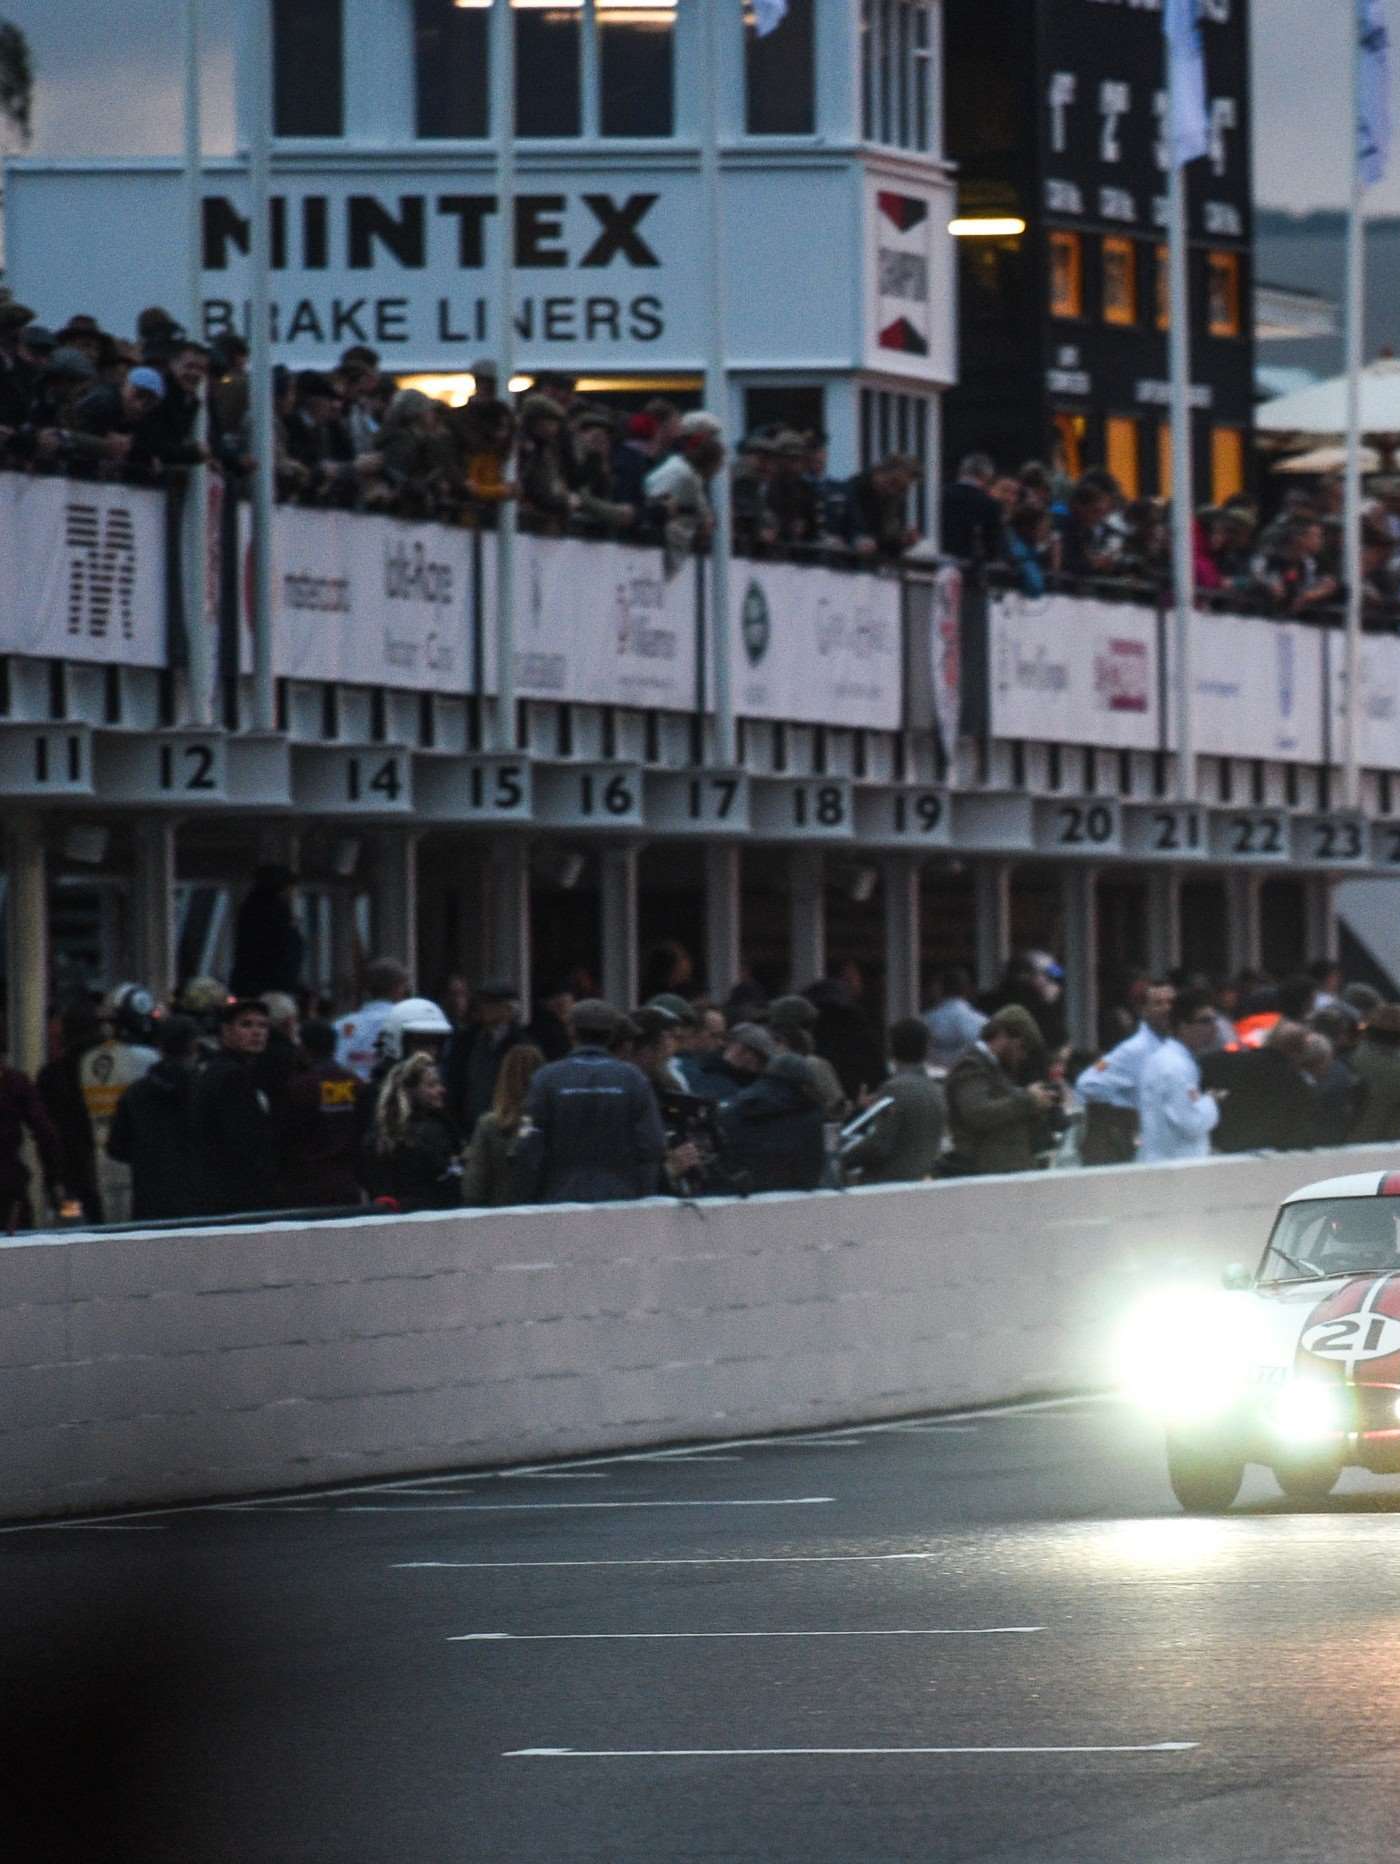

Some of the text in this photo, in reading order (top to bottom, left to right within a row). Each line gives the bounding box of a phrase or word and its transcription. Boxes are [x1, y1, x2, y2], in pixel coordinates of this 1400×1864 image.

[202, 194, 663, 272] MINTEX
[35, 735, 81, 783] 11
[160, 744, 215, 790] 12
[348, 757, 402, 801] 14
[472, 766, 521, 809] 15
[581, 774, 633, 816] 16
[690, 778, 738, 819] 17
[794, 786, 844, 828] 18
[895, 793, 942, 833] 19
[1060, 806, 1112, 843] 20
[1156, 812, 1199, 850] 21
[1232, 817, 1282, 854] 22
[1316, 822, 1363, 859] 23
[1310, 1318, 1386, 1351] 21
